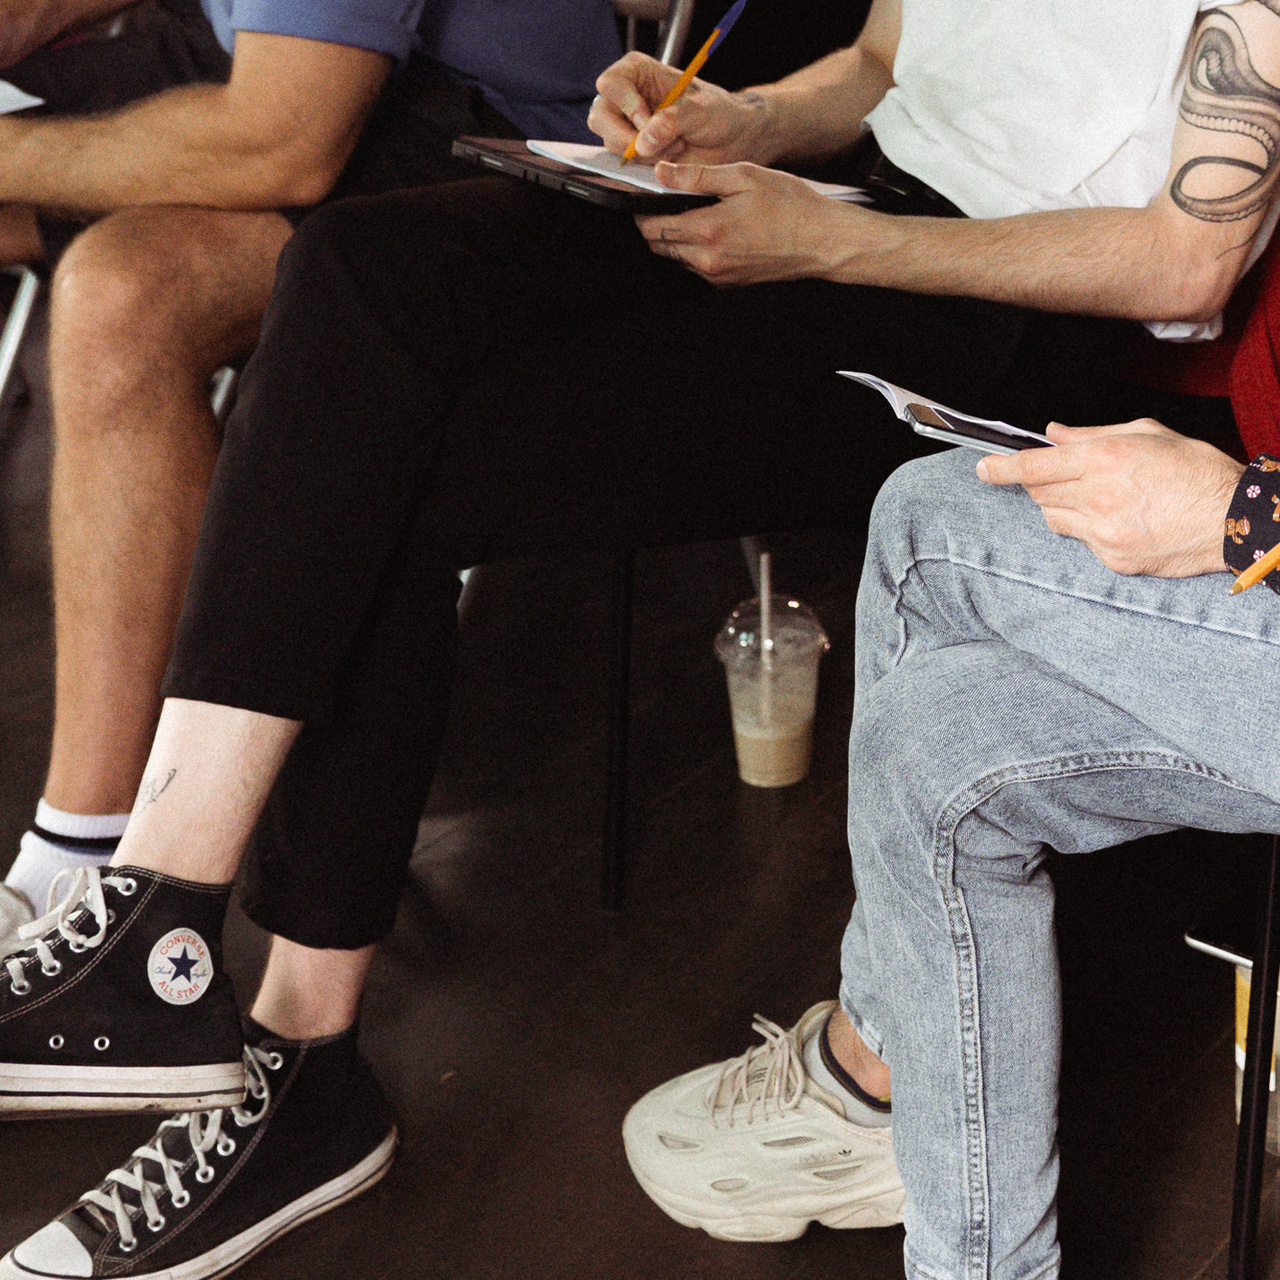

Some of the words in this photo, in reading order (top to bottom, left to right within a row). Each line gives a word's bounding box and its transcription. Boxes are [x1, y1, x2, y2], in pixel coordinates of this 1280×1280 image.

[160, 934, 206, 959] CONVERSE
[158, 981, 174, 997] ALL
[176, 983, 200, 999] STAR
